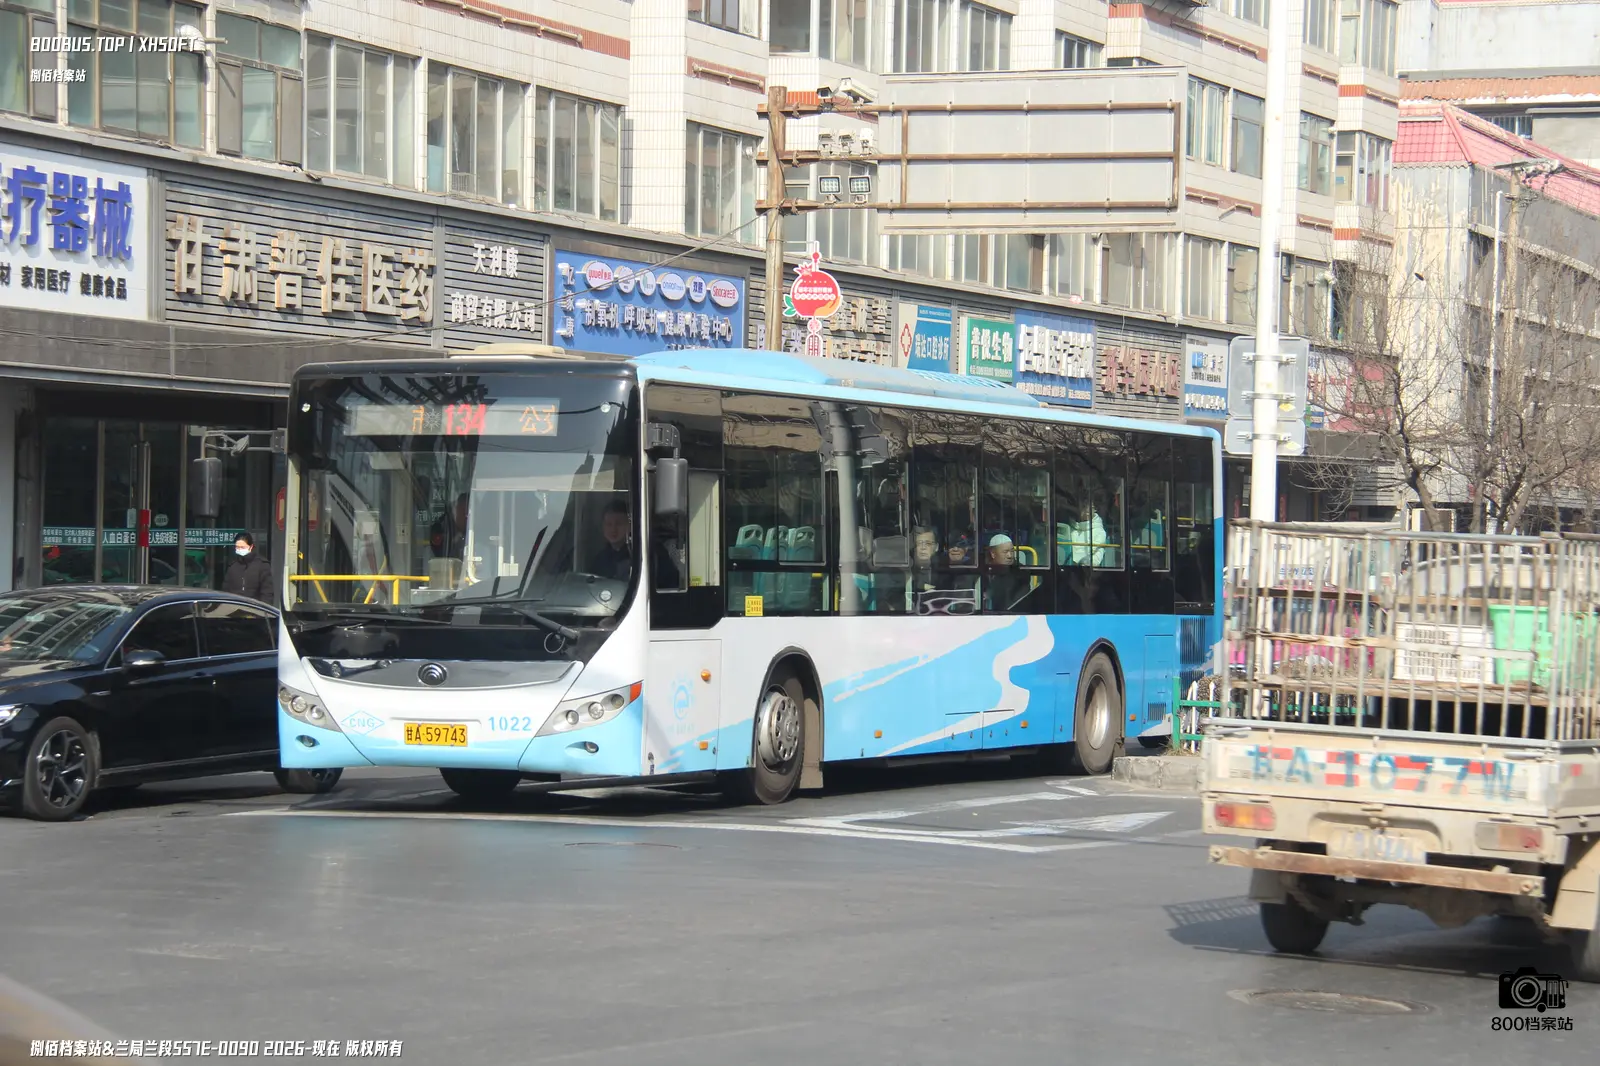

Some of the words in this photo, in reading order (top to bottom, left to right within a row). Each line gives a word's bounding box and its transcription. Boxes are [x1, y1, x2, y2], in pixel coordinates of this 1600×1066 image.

[0, 162, 133, 261] 疗器械
[167, 214, 437, 323] 甘肃普佳医药
[472, 243, 519, 278] 天利康
[21, 264, 71, 293] 家用医疗
[80, 271, 128, 300] 健康食品
[450, 291, 536, 331] 商贸有限公司
[583, 301, 620, 328] 制氧机
[624, 304, 660, 334] 呼吸机
[662, 310, 734, 343] 健康体验中心
[445, 404, 487, 436] 134
[102, 531, 136, 544] 人血白蛋白
[349, 717, 377, 729] CNG
[489, 716, 532, 732] 1022
